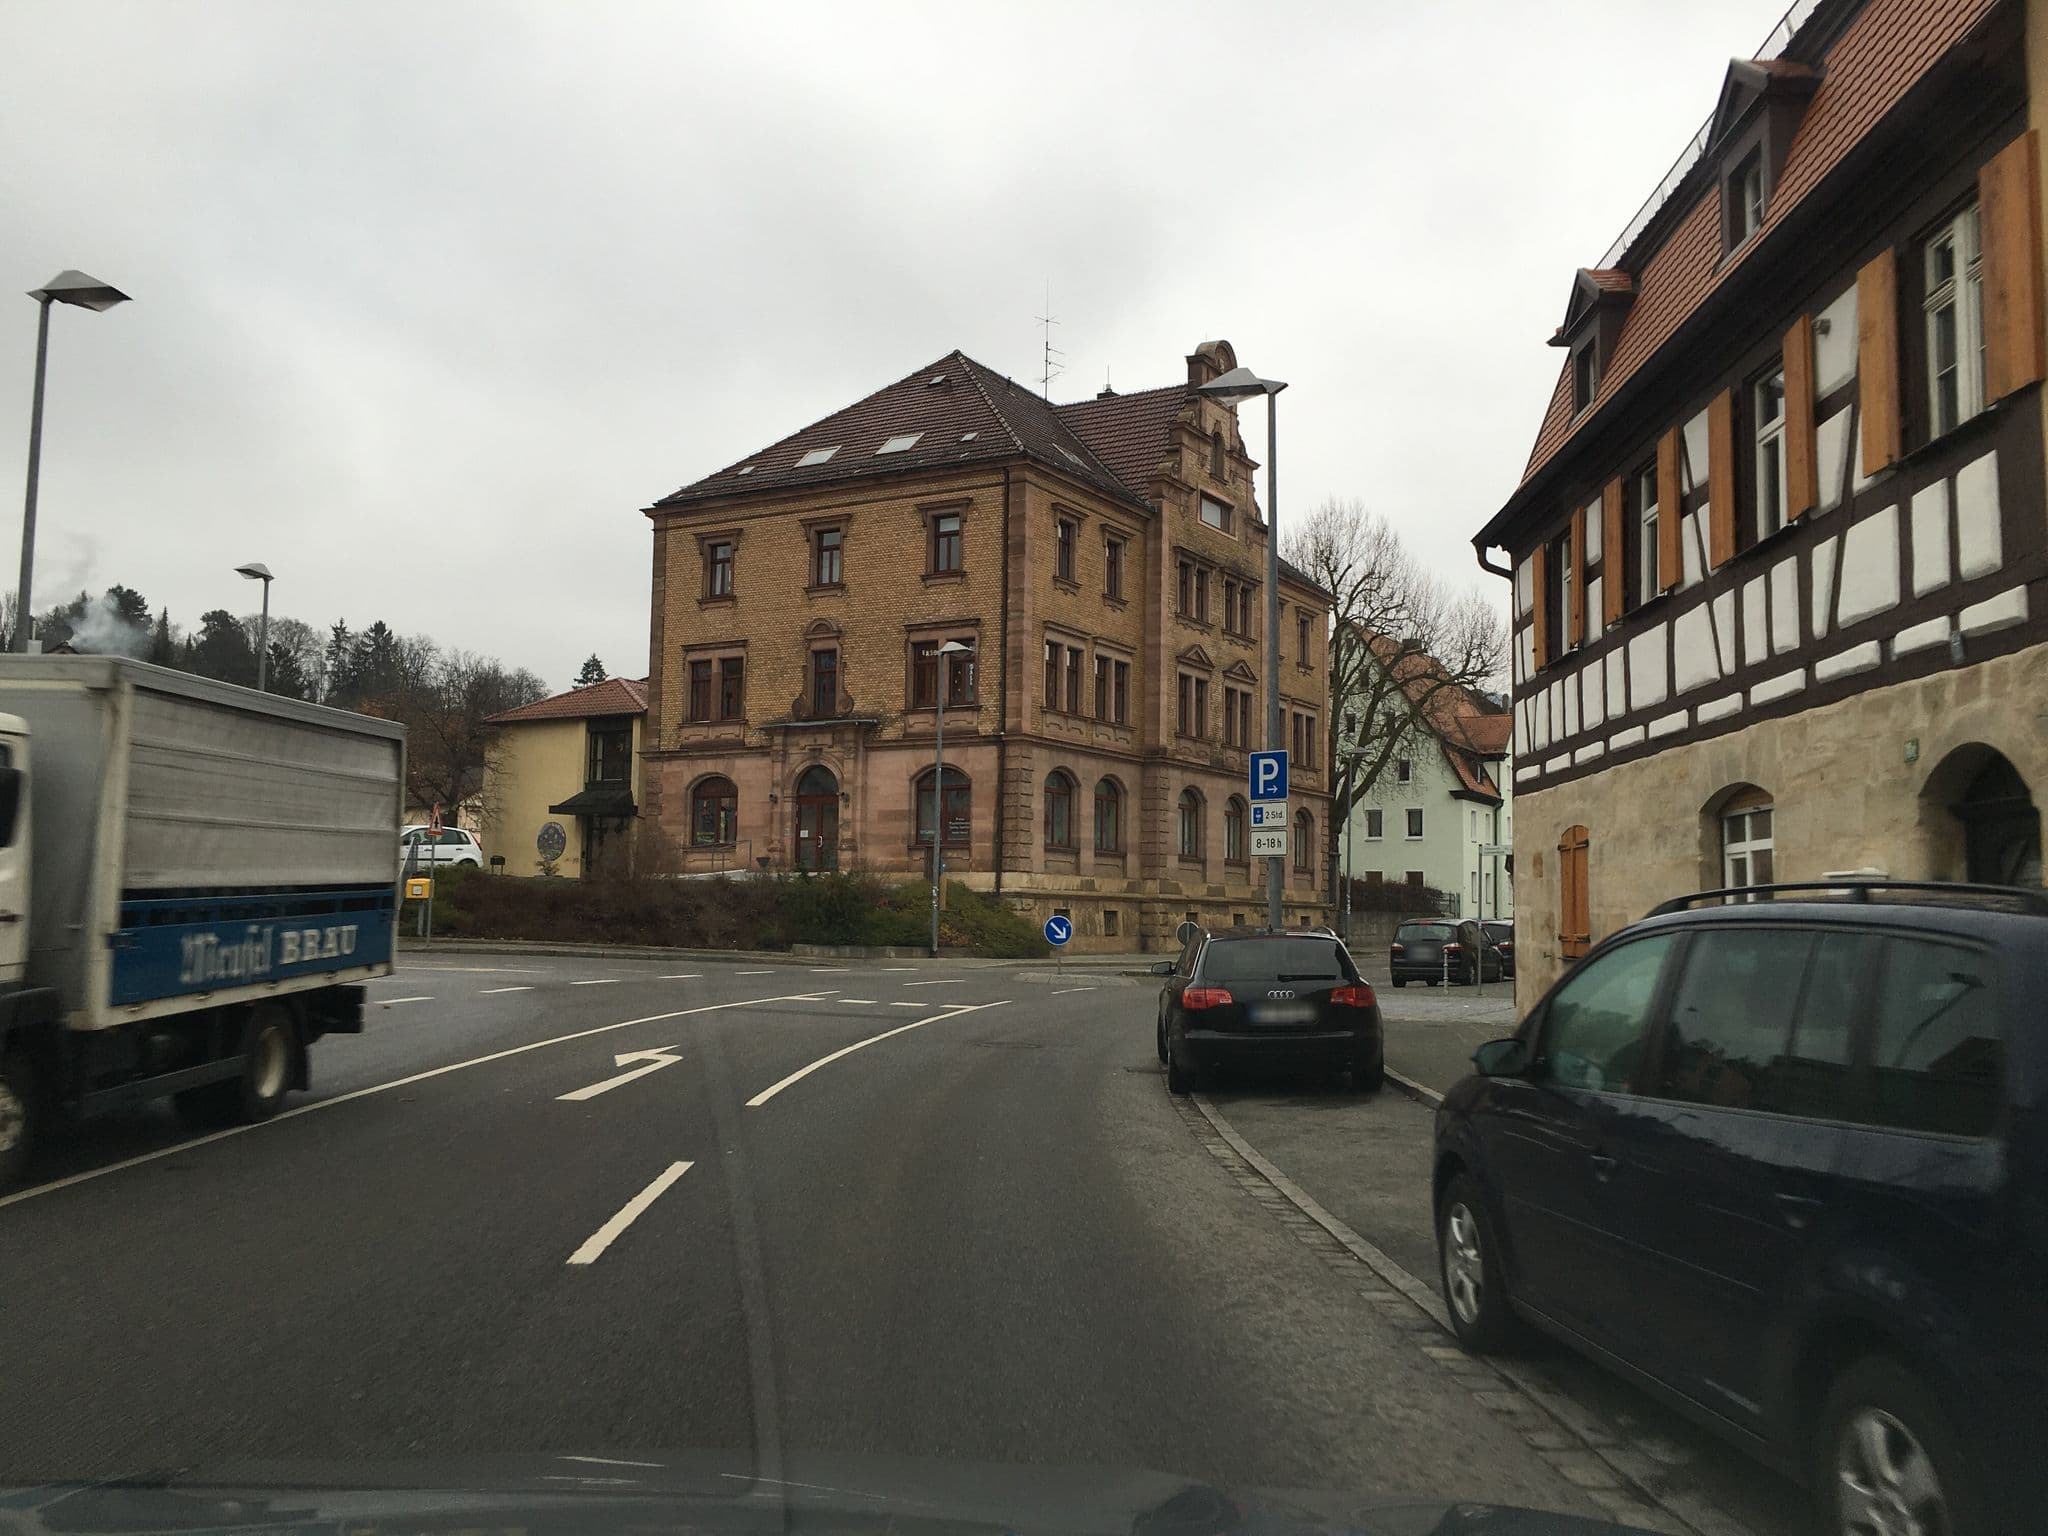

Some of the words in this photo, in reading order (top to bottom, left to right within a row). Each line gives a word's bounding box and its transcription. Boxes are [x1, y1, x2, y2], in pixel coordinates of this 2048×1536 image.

[1258, 758, 1279, 794] P
[1256, 838, 1276, 849] 8-18
[1277, 838, 1282, 849] h
